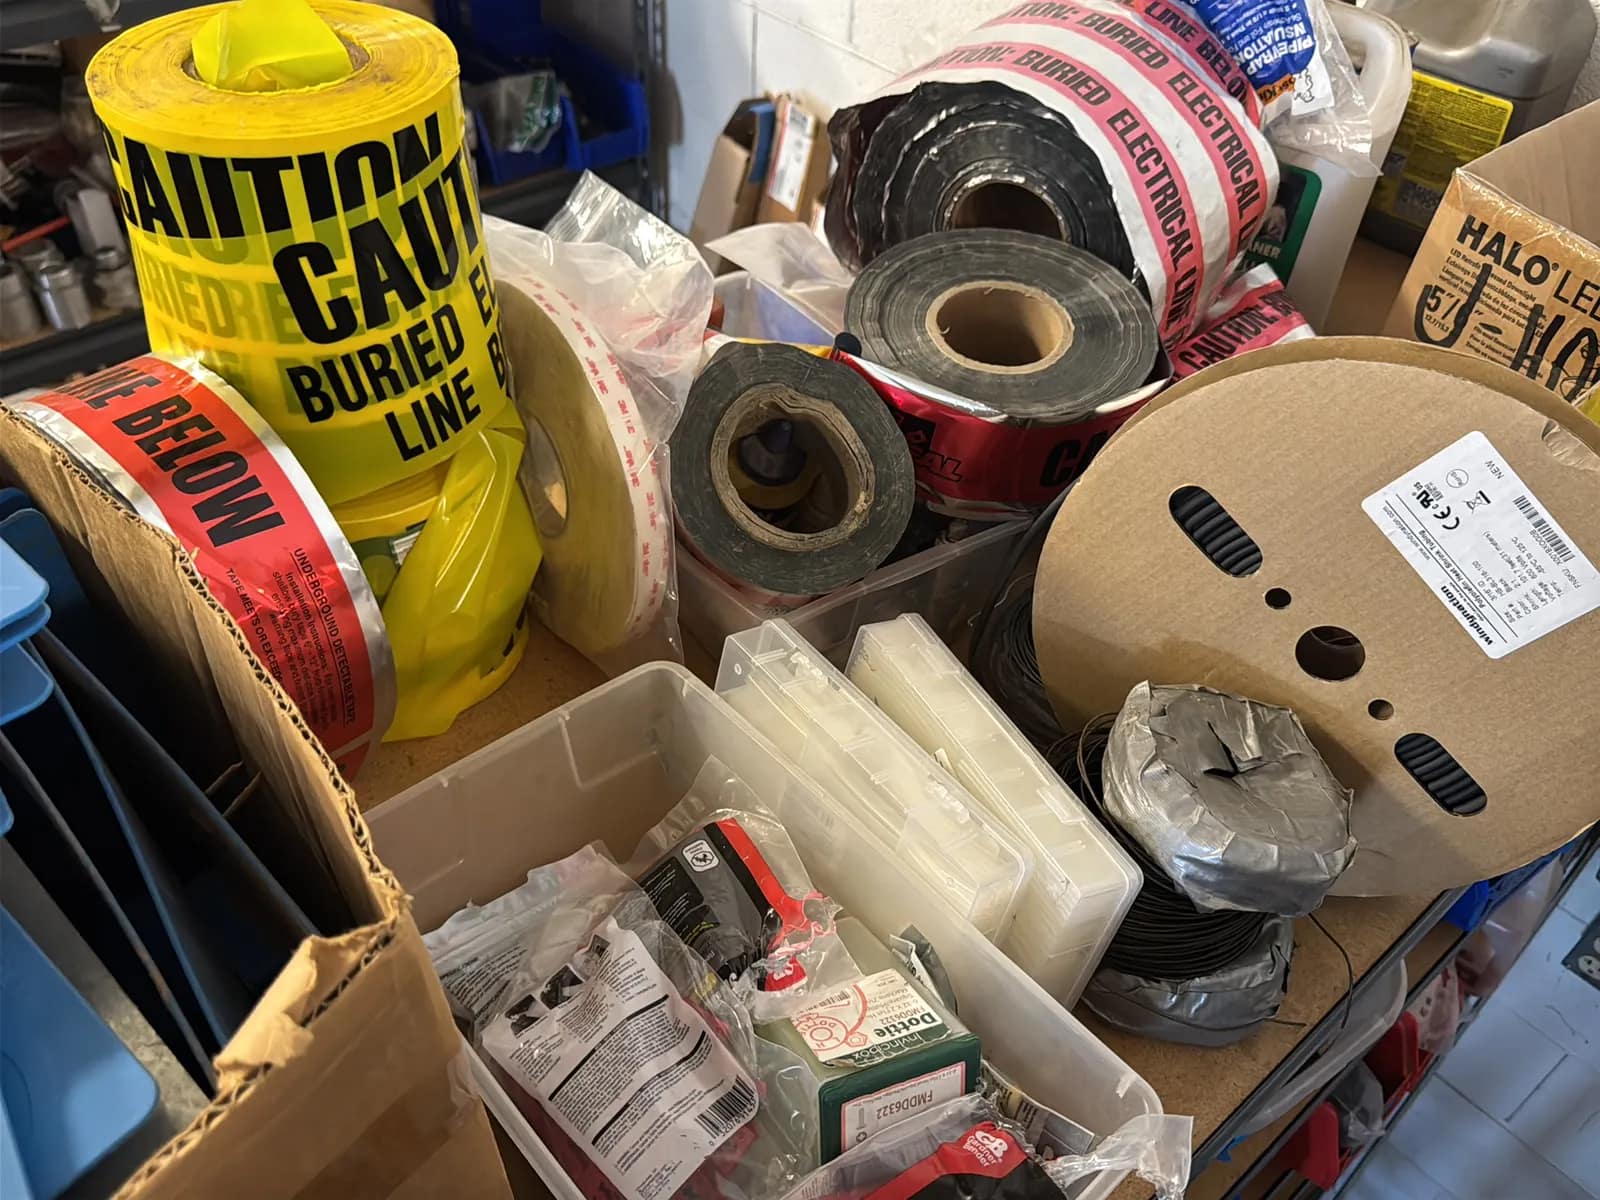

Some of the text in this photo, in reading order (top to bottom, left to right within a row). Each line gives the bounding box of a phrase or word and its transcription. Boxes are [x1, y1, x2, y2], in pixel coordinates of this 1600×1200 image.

[1144, 2, 1198, 43] LINE
[1077, 12, 1169, 70] BURIED
[1167, 71, 1261, 218] ELECTRICAL
[1013, 50, 1112, 106] BURIED
[1107, 108, 1193, 273] ELECTRICAL
[286, 304, 465, 424] BURIED
[384, 367, 482, 462] LINE
[112, 395, 285, 547] BELOW
[1484, 458, 1504, 480] NEW
[1417, 528, 1437, 550] Tubing
[1434, 549, 1452, 569] Shrink
[294, 547, 339, 637] UNDERGROUND
[1449, 567, 1463, 582] Heat
[226, 567, 245, 593] TAPE
[240, 593, 260, 627] MEETS
[255, 626, 267, 641] OR
[285, 571, 312, 622] Installation
[1438, 583, 1495, 646] windynation
[874, 1011, 938, 1038] Dottie
[876, 1089, 934, 1121] FMDD6322
[962, 1143, 991, 1169] Bender
[966, 1135, 999, 1165] Gardner
[975, 1130, 1009, 1158] GB
